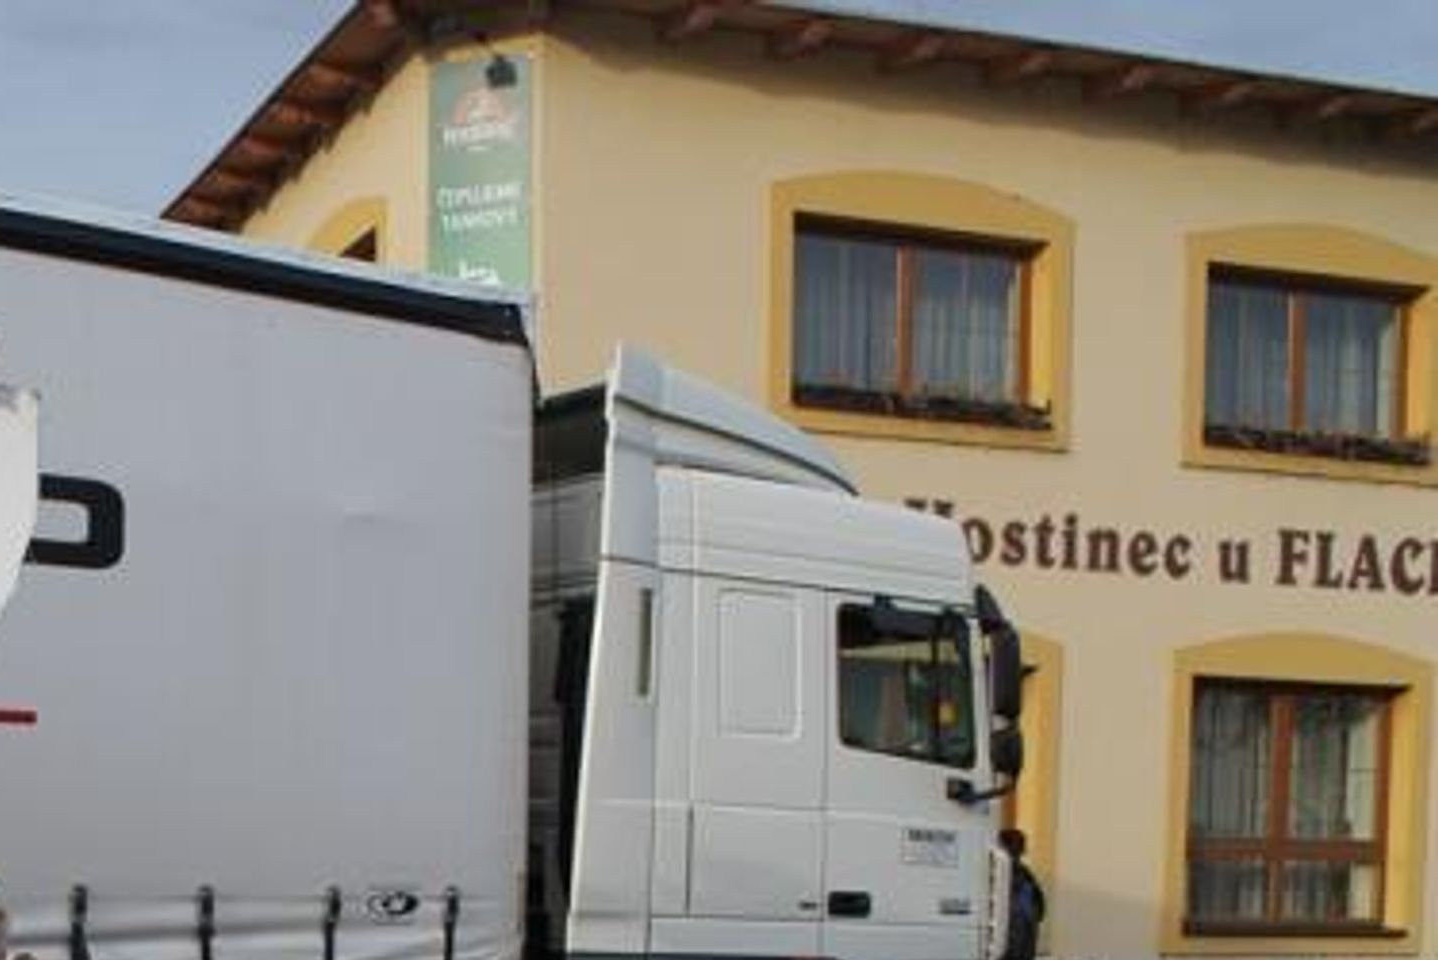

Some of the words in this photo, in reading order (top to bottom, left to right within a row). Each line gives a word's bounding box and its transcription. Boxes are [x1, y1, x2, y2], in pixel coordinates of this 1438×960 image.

[905, 498, 1192, 578] ostinec
[1218, 539, 1251, 584] u
[1275, 528, 1438, 597] FLAC
